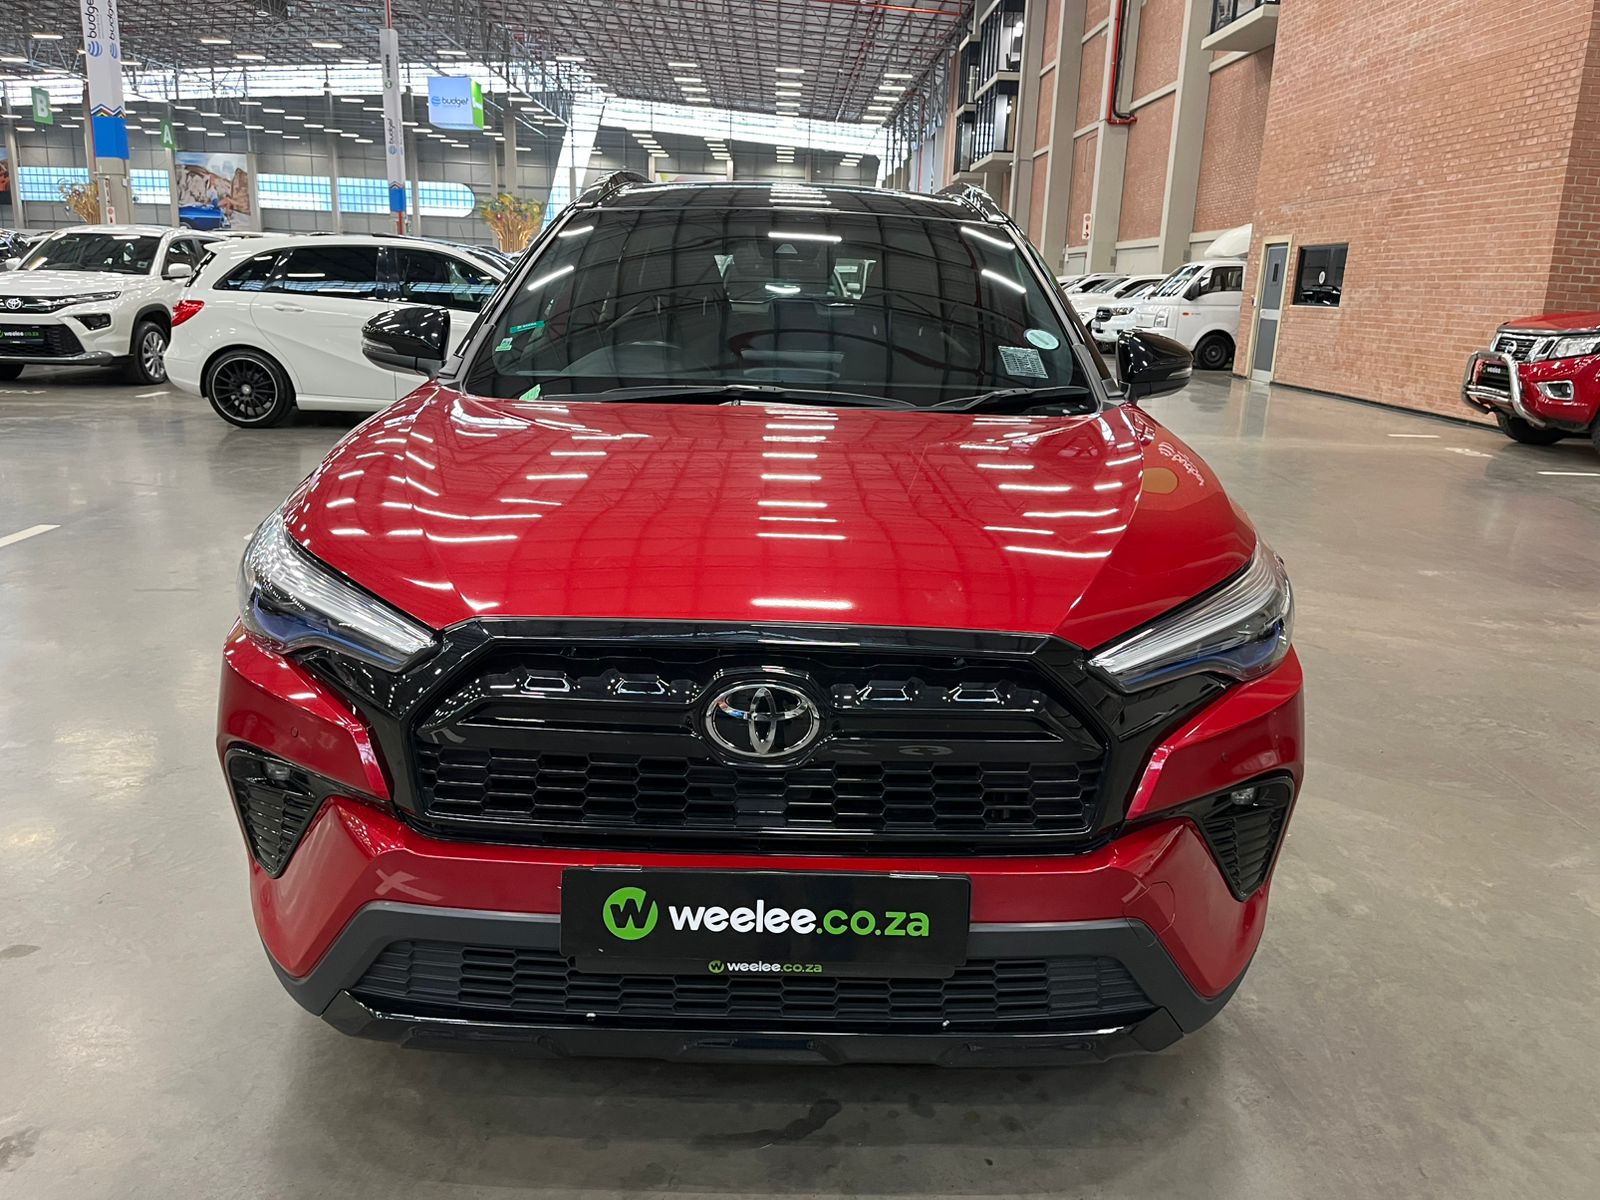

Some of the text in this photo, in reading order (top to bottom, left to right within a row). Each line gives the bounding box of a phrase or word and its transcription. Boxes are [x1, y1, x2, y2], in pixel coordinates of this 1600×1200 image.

[36, 93, 48, 118] B
[442, 97, 468, 107] budget
[163, 124, 173, 145] A
[668, 900, 930, 937] weelee.co.za
[727, 961, 822, 973] weelee.co.za
